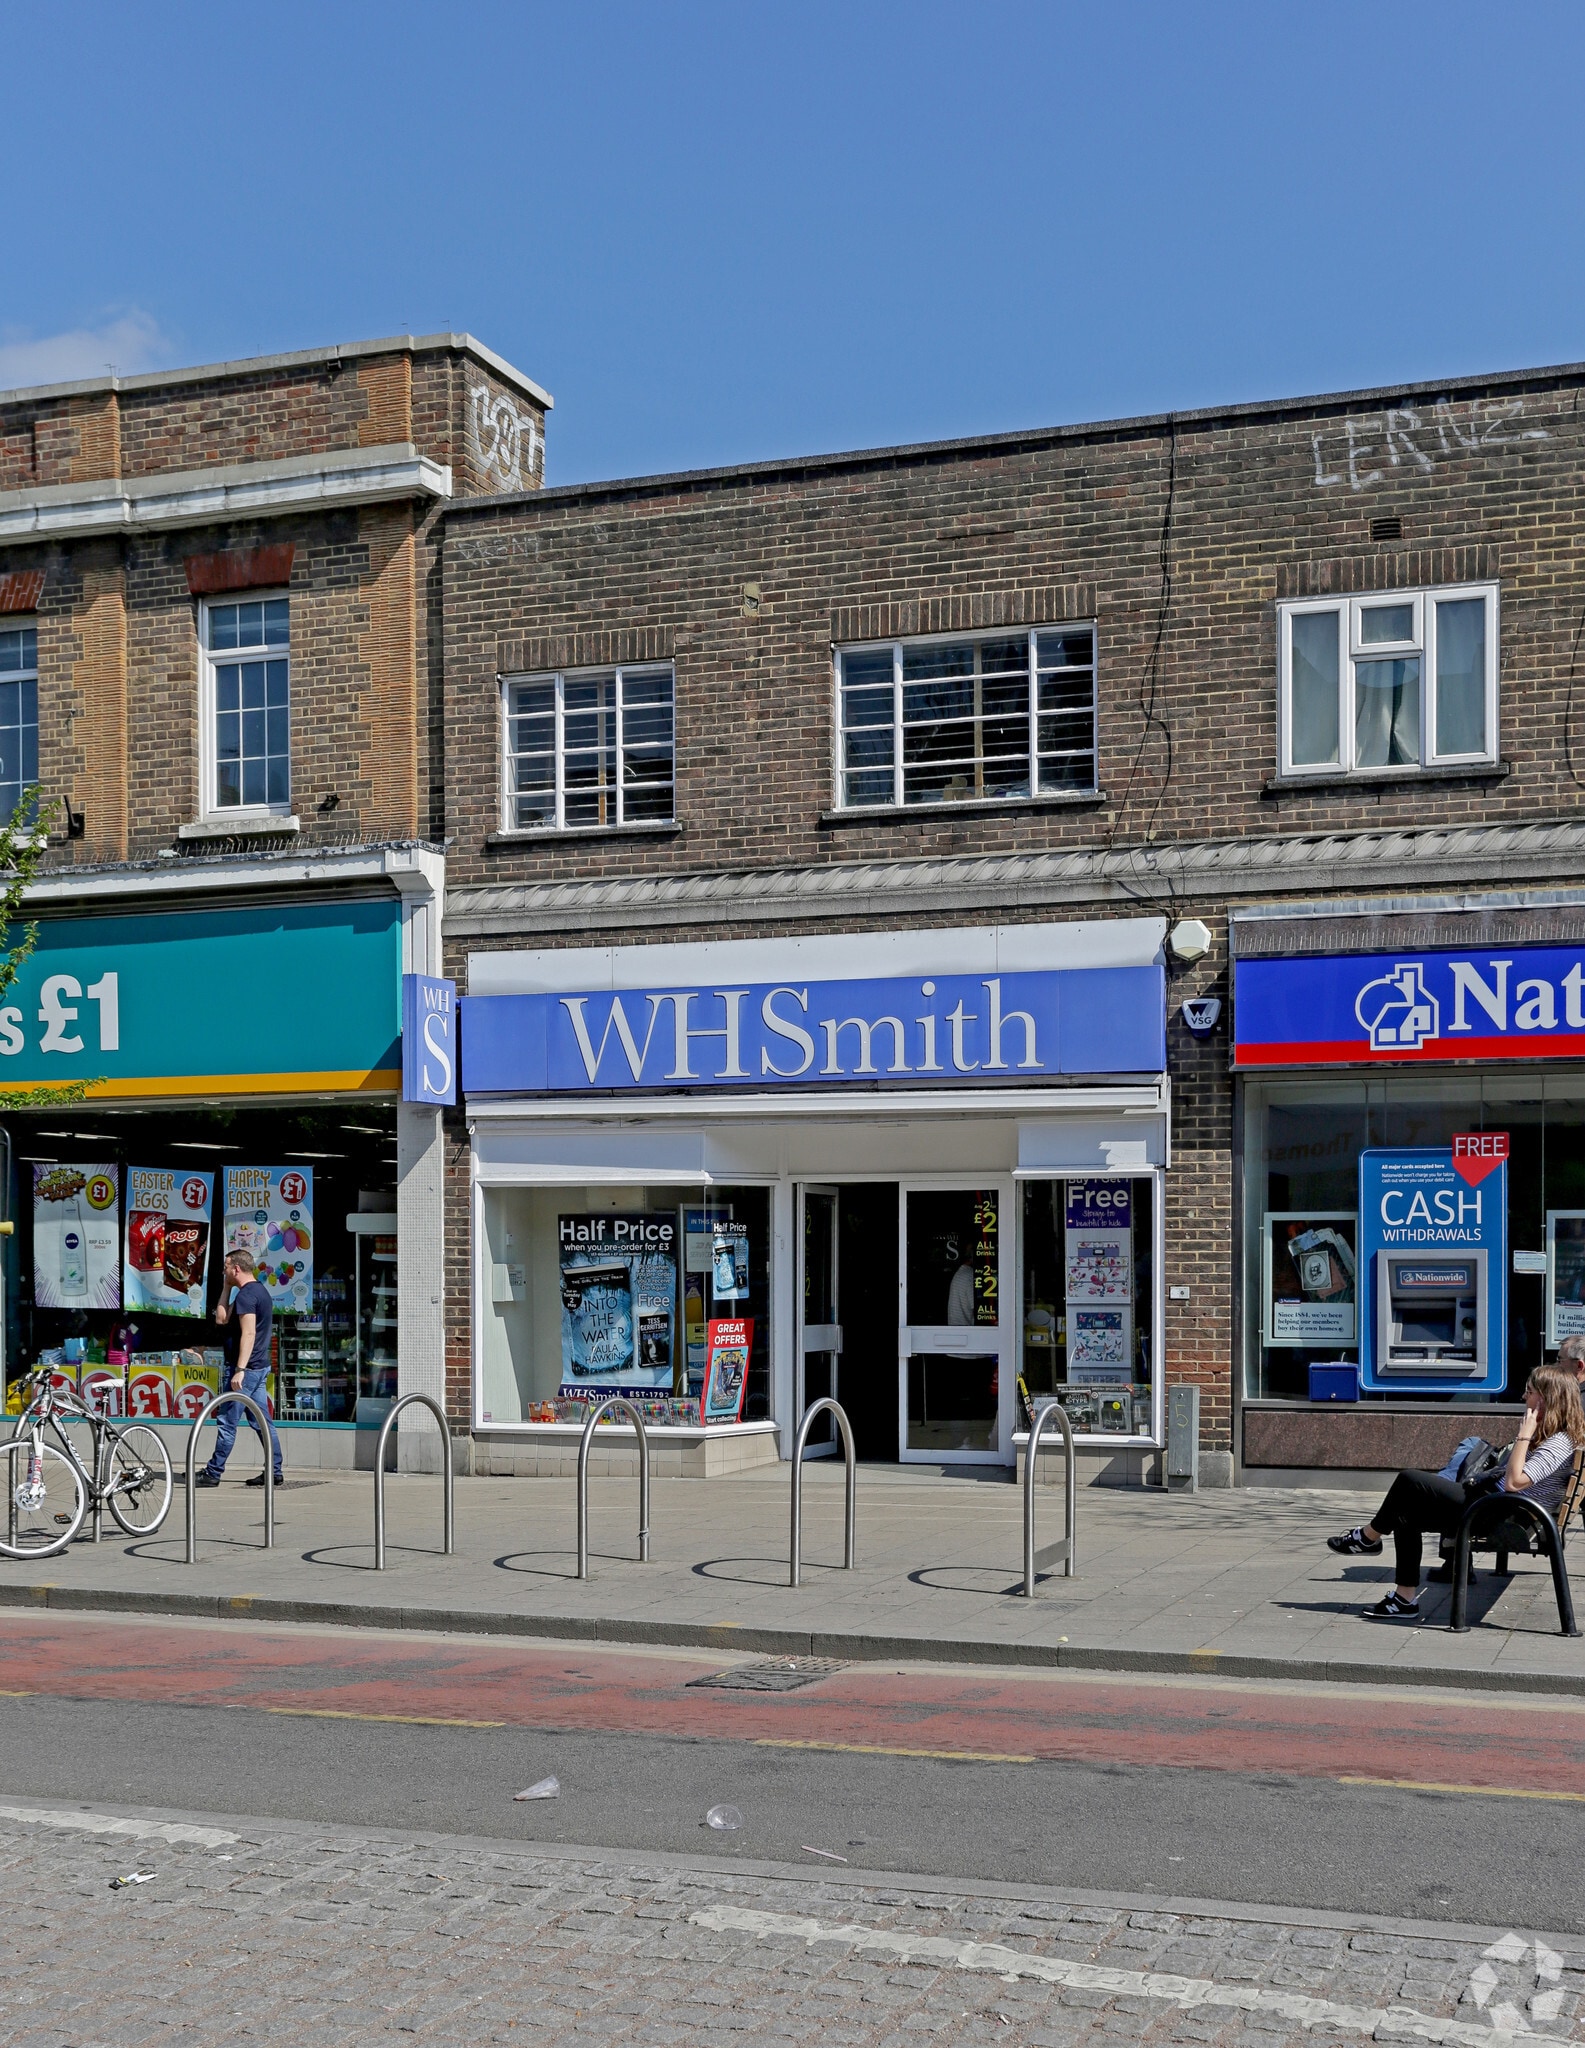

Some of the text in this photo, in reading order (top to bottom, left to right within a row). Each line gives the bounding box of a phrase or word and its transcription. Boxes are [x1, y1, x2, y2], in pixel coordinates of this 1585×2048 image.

[423, 986, 450, 1013] WH
[38, 971, 119, 1054] £1
[1191, 1016, 1212, 1025] VSG
[558, 977, 1046, 1085] WHSmith
[424, 1013, 452, 1096] S
[1455, 1136, 1506, 1157] FREE
[132, 1171, 174, 1191] EASTER
[228, 1169, 271, 1188] HAPPY
[93, 1185, 107, 1198] £1
[185, 1183, 205, 1205] £1
[283, 1178, 303, 1200] £1
[1068, 1185, 1129, 1208] Free
[135, 1192, 169, 1210] EGGS
[228, 1190, 271, 1208] EASTER
[983, 1200, 990, 1211] 2
[1381, 1190, 1482, 1226] CASH
[713, 1222, 747, 1232] Half Price
[974, 1211, 997, 1232] £2
[560, 1219, 674, 1241] Half Price
[1383, 1228, 1482, 1242] WITHDRAWALS
[564, 1243, 670, 1255] when you pre-order for £3
[976, 1241, 995, 1249] ALL
[983, 1265, 991, 1275] 2
[1415, 1273, 1464, 1282] Nationwide
[974, 1276, 997, 1297] £2
[584, 1296, 618, 1313] INTO
[638, 1293, 670, 1307] Free
[977, 1305, 996, 1313] ALL
[590, 1312, 614, 1327] THE
[647, 1317, 660, 1325] TESS
[582, 1326, 626, 1344] WATER
[717, 1323, 745, 1333] GREAT
[714, 1334, 746, 1345] OFFERS
[592, 1343, 619, 1355] PAULA
[585, 1351, 626, 1364] HAWKINS
[183, 1368, 210, 1382] WOW!
[132, 1380, 170, 1418] £1
[562, 1388, 624, 1402] WHSmith
[706, 1414, 737, 1424] Start collecting
[1175, 1404, 1189, 1428] 5
[1385, 1603, 1399, 1614] N
